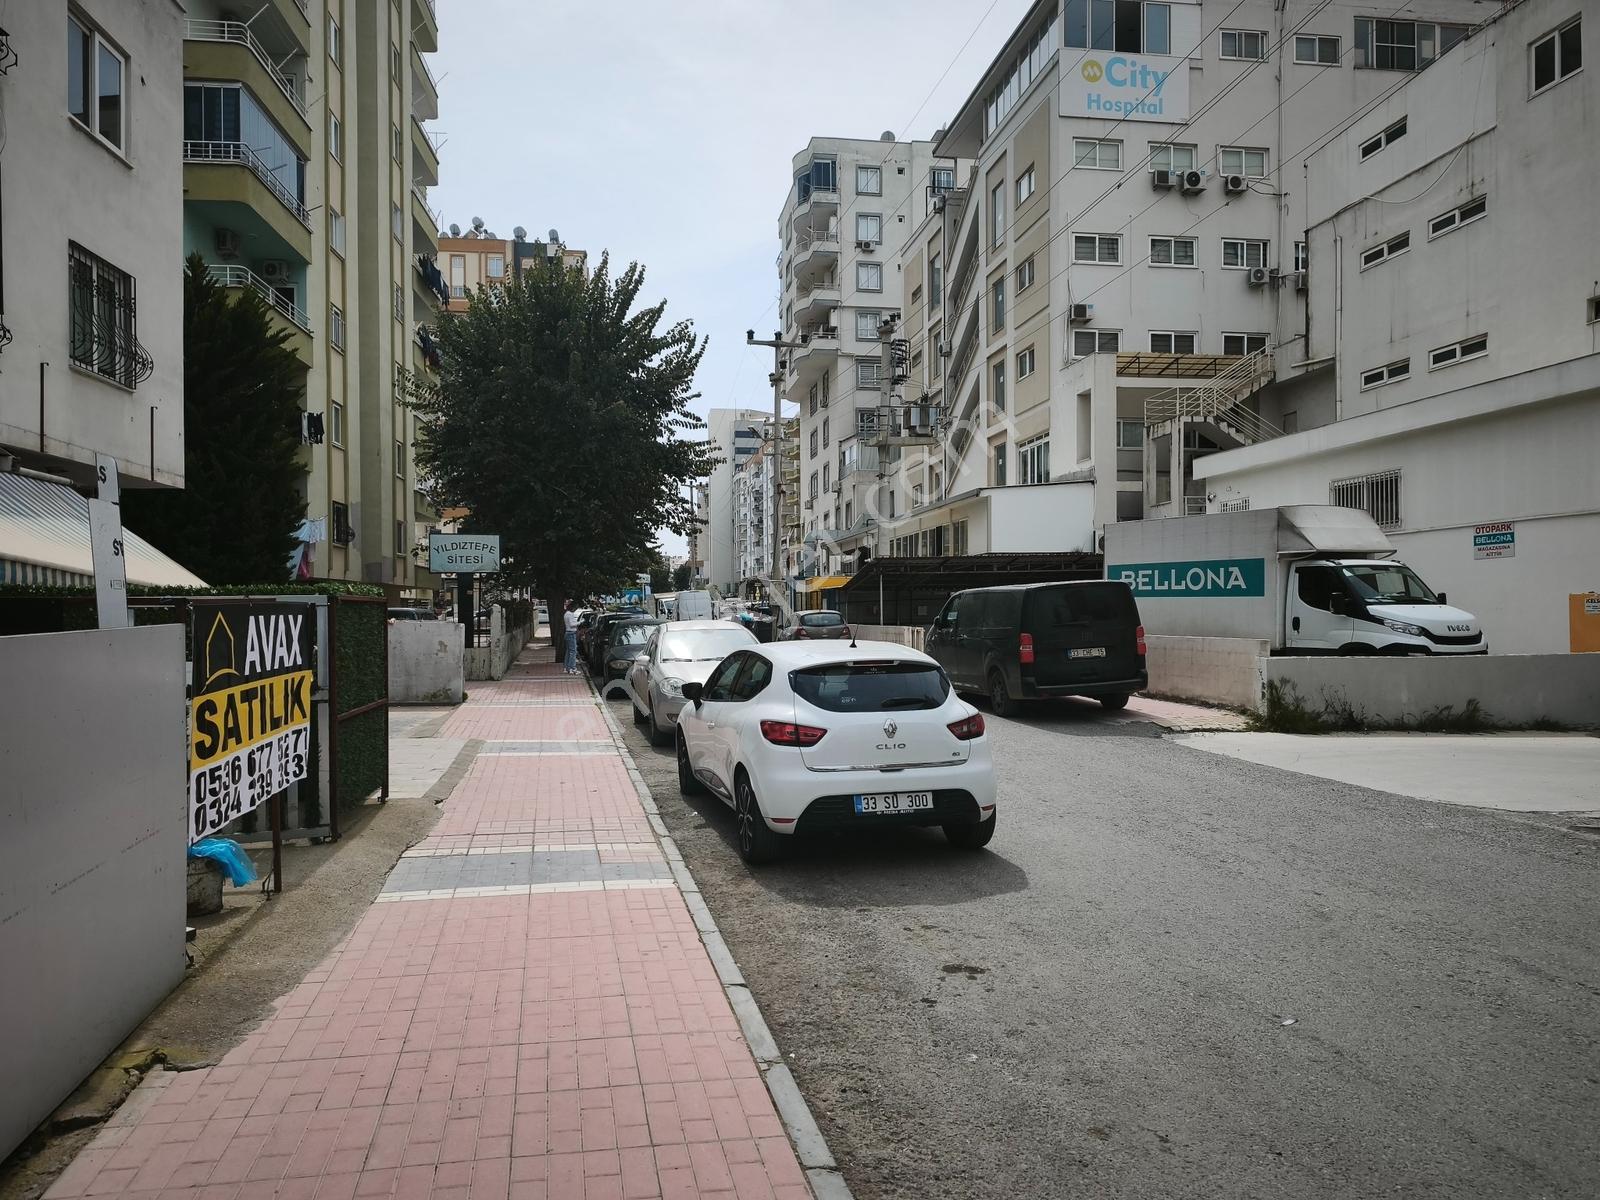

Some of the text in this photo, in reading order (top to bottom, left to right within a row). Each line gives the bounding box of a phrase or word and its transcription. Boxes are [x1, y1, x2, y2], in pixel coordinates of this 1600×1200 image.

[1105, 56, 1168, 97] City
[1087, 93, 1163, 117] Hospital
[1475, 523, 1512, 534] OTOPARK
[1475, 534, 1512, 544] BELLONA
[433, 541, 497, 554] YILDIZTEPE
[447, 553, 484, 564] SİTESİ
[1120, 566, 1247, 590] BELLONA
[1446, 624, 1471, 632] IVECO
[244, 614, 303, 676] AVAX
[194, 675, 307, 760] SATILIK
[195, 755, 242, 804] 0536
[247, 741, 273, 778] 677
[195, 786, 242, 836] 0324
[248, 768, 273, 807] 239
[863, 797, 877, 810] 33
[907, 794, 928, 808] 300
